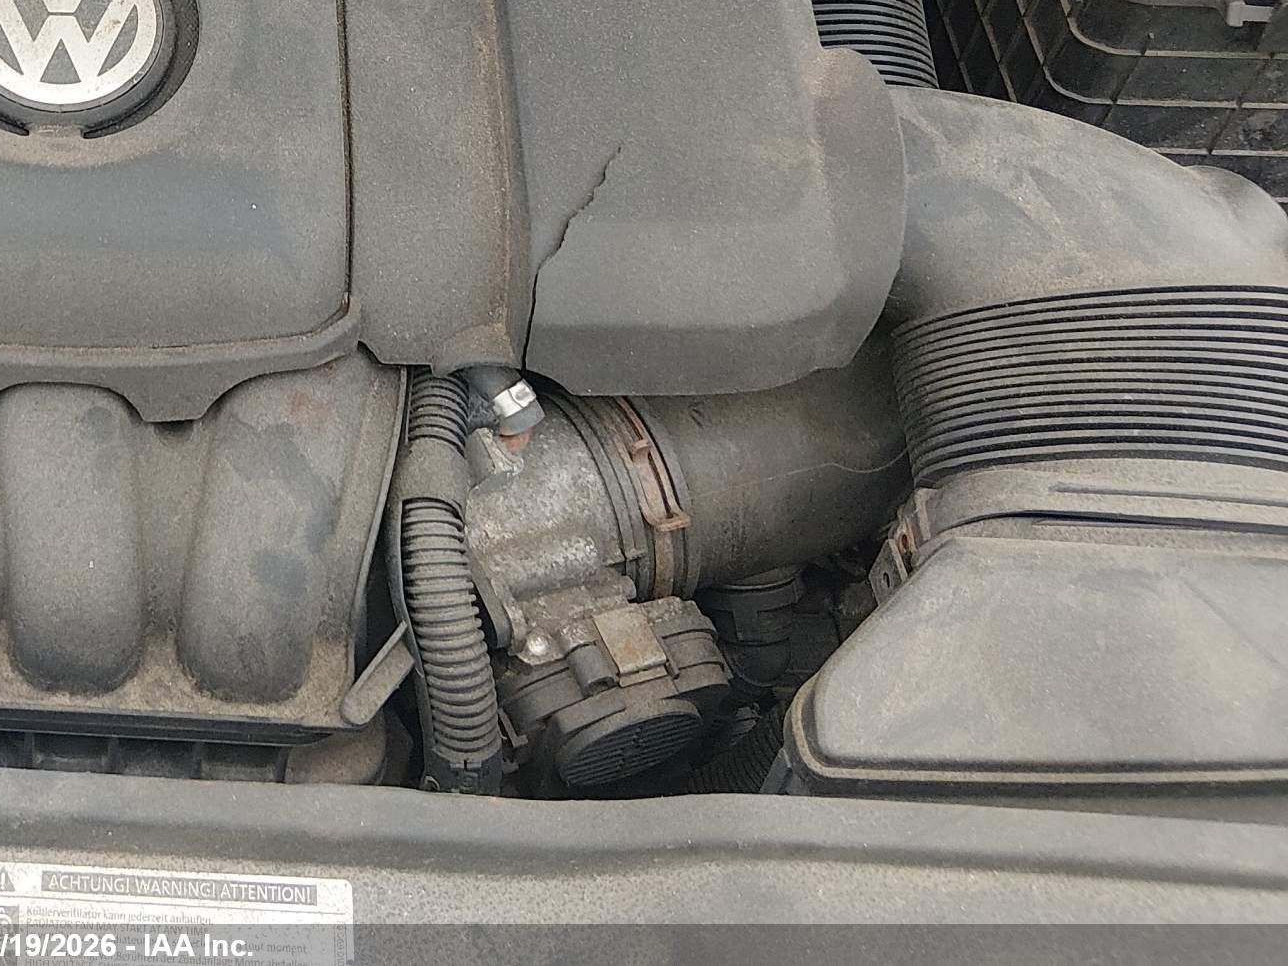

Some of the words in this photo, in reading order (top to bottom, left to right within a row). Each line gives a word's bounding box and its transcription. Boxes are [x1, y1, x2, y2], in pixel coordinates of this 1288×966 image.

[48, 873, 130, 893] ACHTUNG!
[135, 878, 216, 899] WARNING!
[220, 883, 312, 904] ATTENTION!
